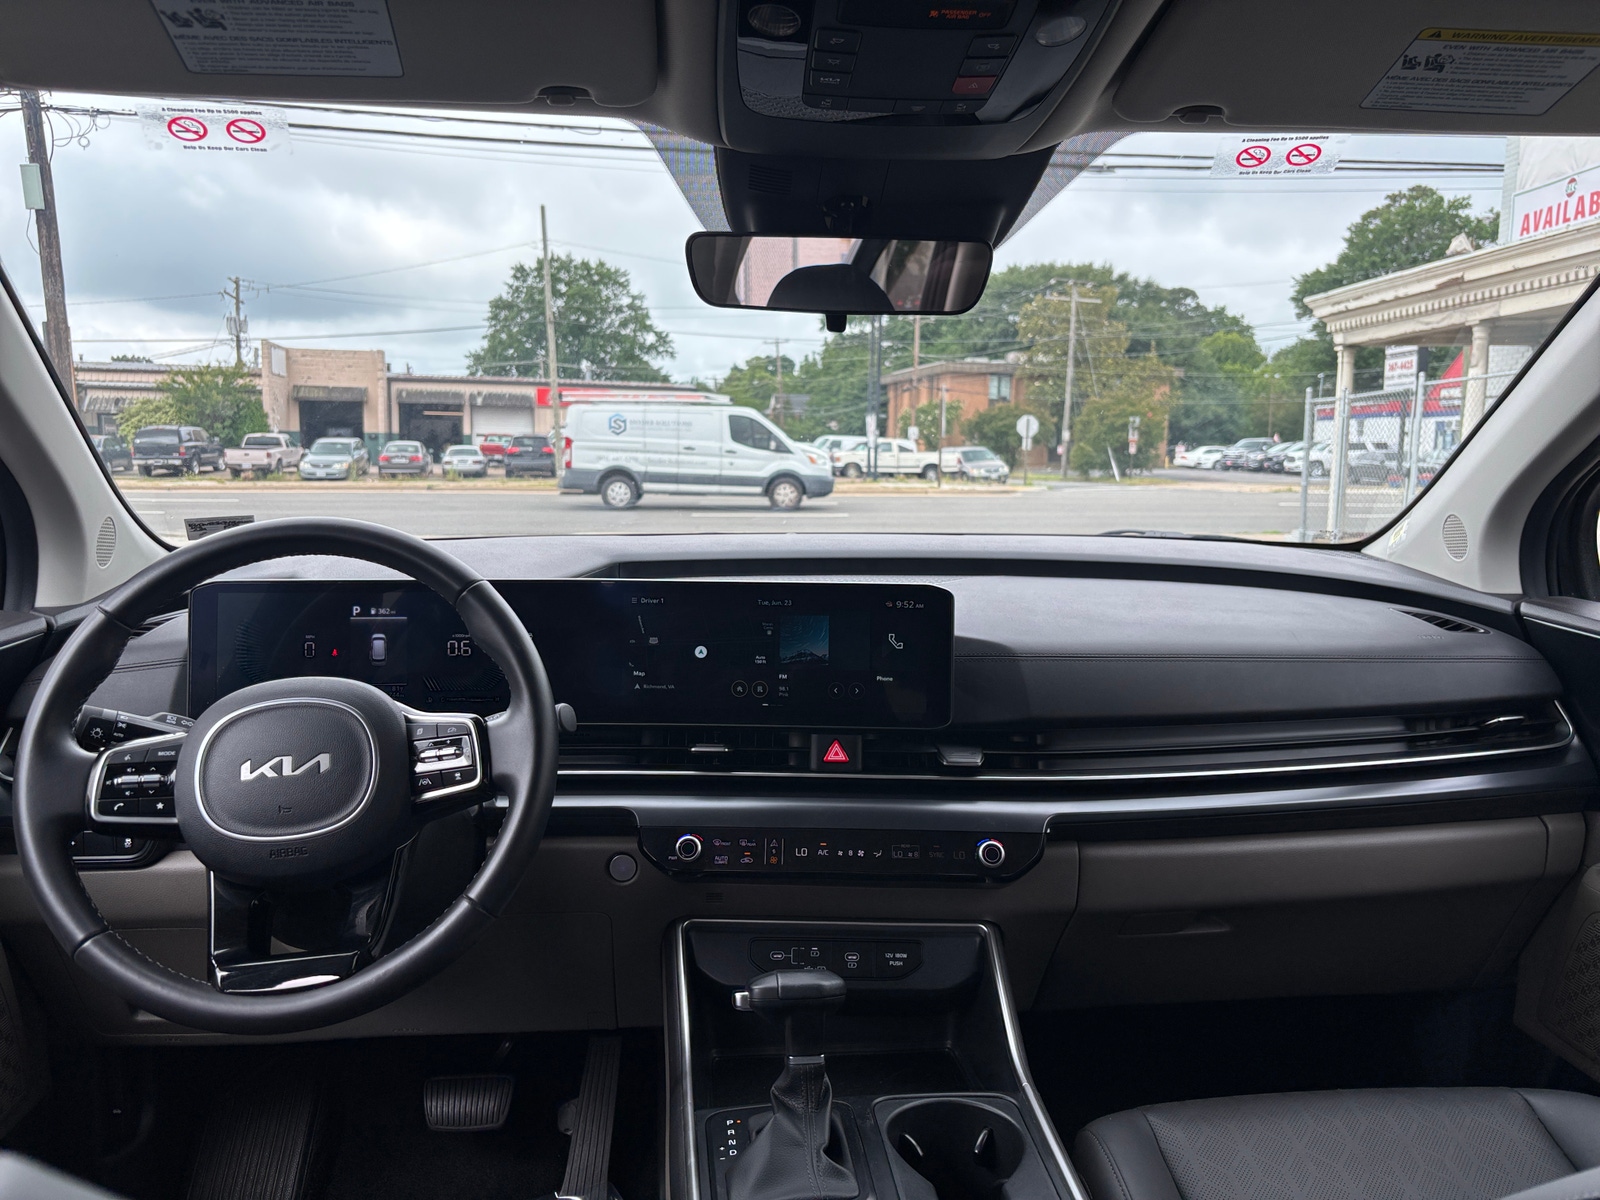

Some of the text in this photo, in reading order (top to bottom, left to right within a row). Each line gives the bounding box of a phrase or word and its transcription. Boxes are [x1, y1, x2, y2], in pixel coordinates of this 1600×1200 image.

[1520, 190, 1600, 237] AVAILAB
[352, 606, 361, 616] P
[896, 600, 914, 608] 9:52
[304, 642, 315, 658] 0
[448, 640, 472, 656] 0.6
[240, 753, 330, 781] KIA
[270, 846, 308, 858] AIRBAG
[795, 848, 808, 857] LO
